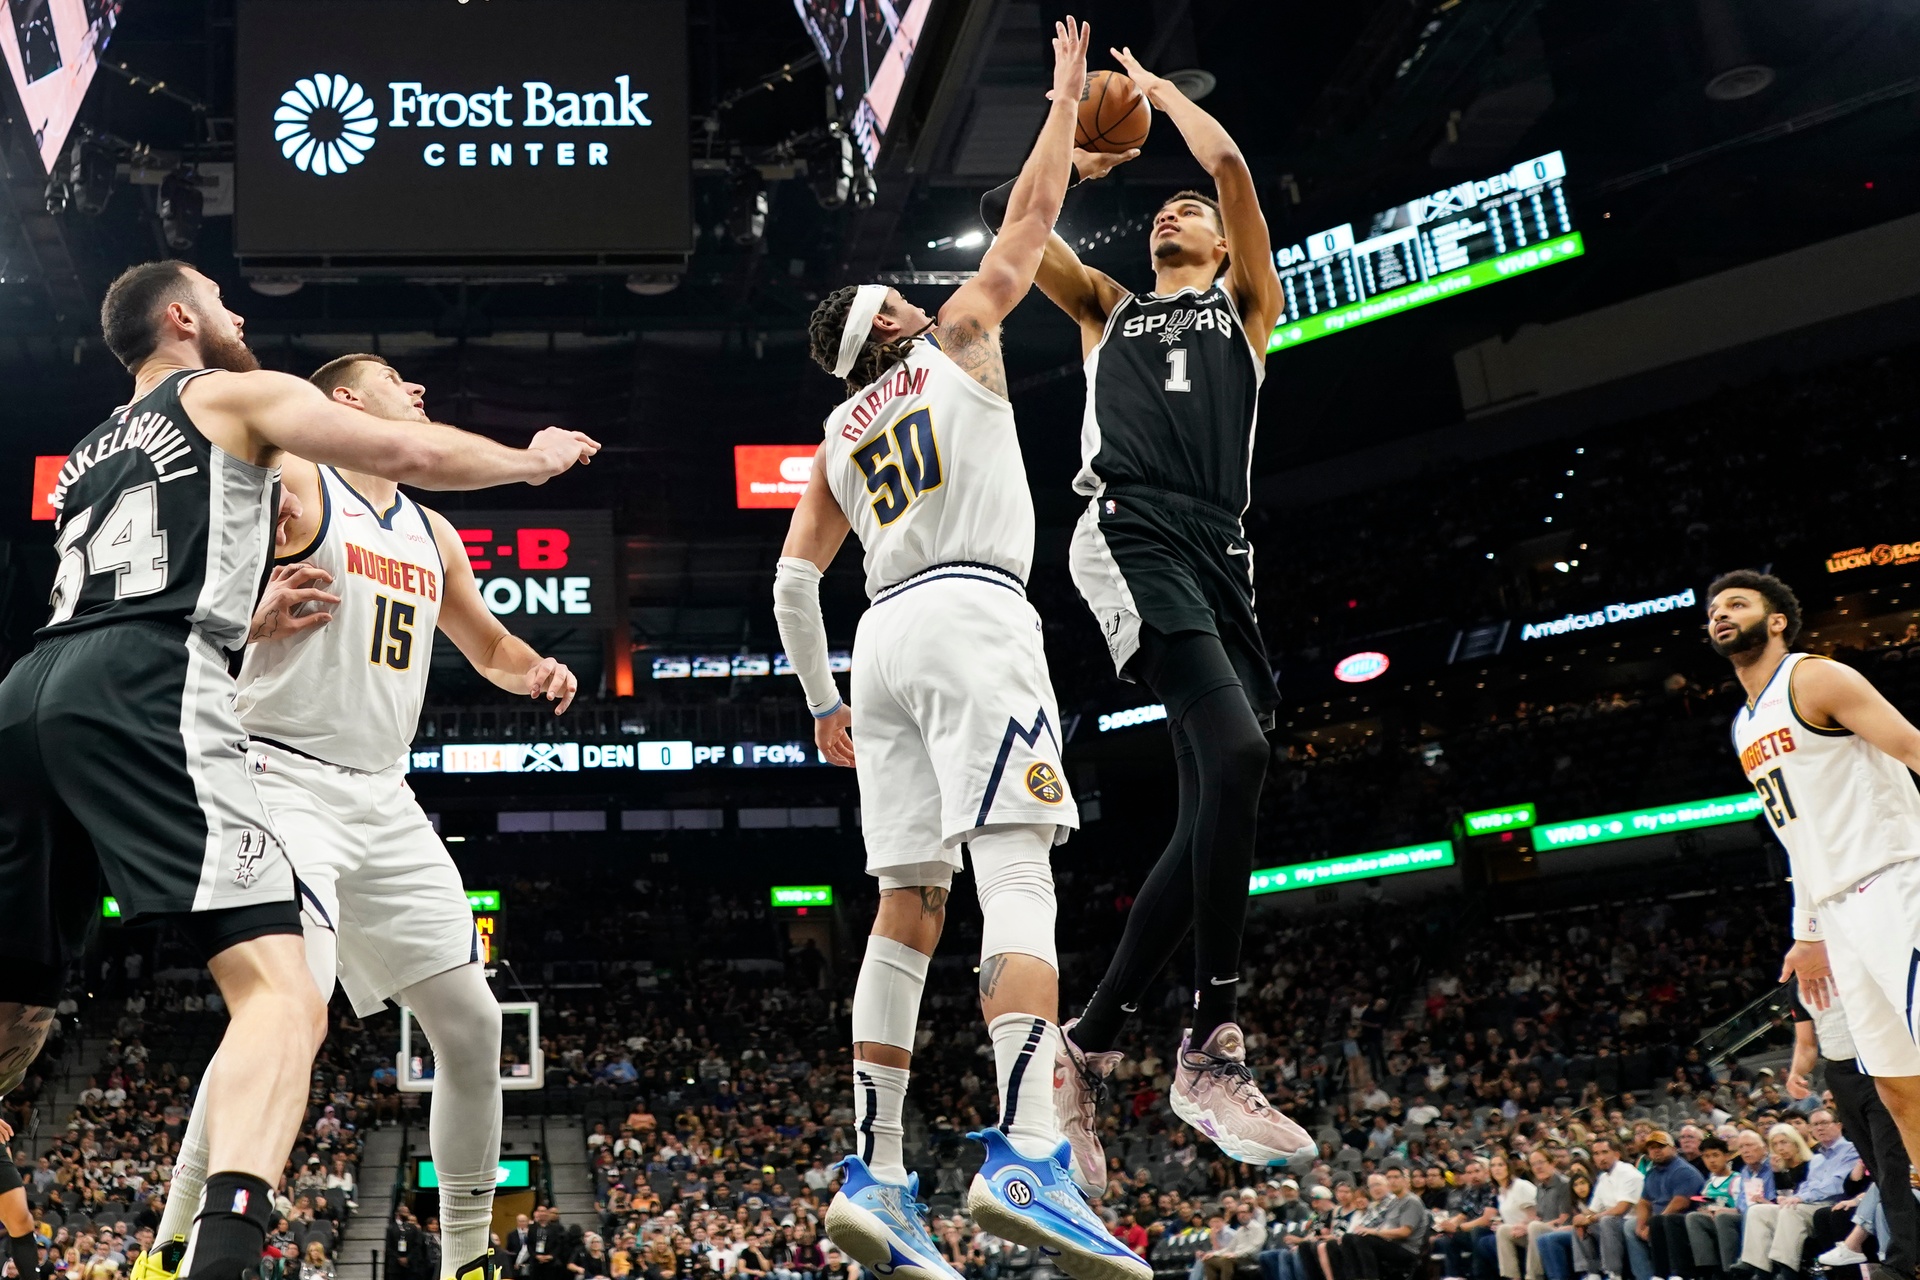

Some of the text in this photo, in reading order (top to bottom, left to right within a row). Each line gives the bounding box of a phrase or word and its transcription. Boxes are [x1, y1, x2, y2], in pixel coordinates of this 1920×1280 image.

[388, 75, 652, 129] Frost Bank
[424, 143, 609, 167] CENTER
[1533, 161, 1547, 180] 0
[1475, 170, 1517, 201] DEN
[1324, 233, 1336, 251] 0
[1122, 308, 1232, 345] SPURS
[1164, 348, 1191, 392] 1
[841, 367, 930, 443] GORDON
[850, 404, 944, 529] 50
[46, 480, 168, 627] 54
[345, 542, 437, 602] NUGGETS
[1826, 552, 1872, 573] LUCKY
[369, 593, 416, 671] 15
[1520, 588, 1696, 641] Americus Diamond
[412, 752, 440, 769] 1ST
[450, 751, 502, 771] 11:14
[583, 745, 634, 768] DEN
[660, 747, 671, 766] 0
[694, 747, 725, 764] PF
[752, 745, 805, 764] FG%
